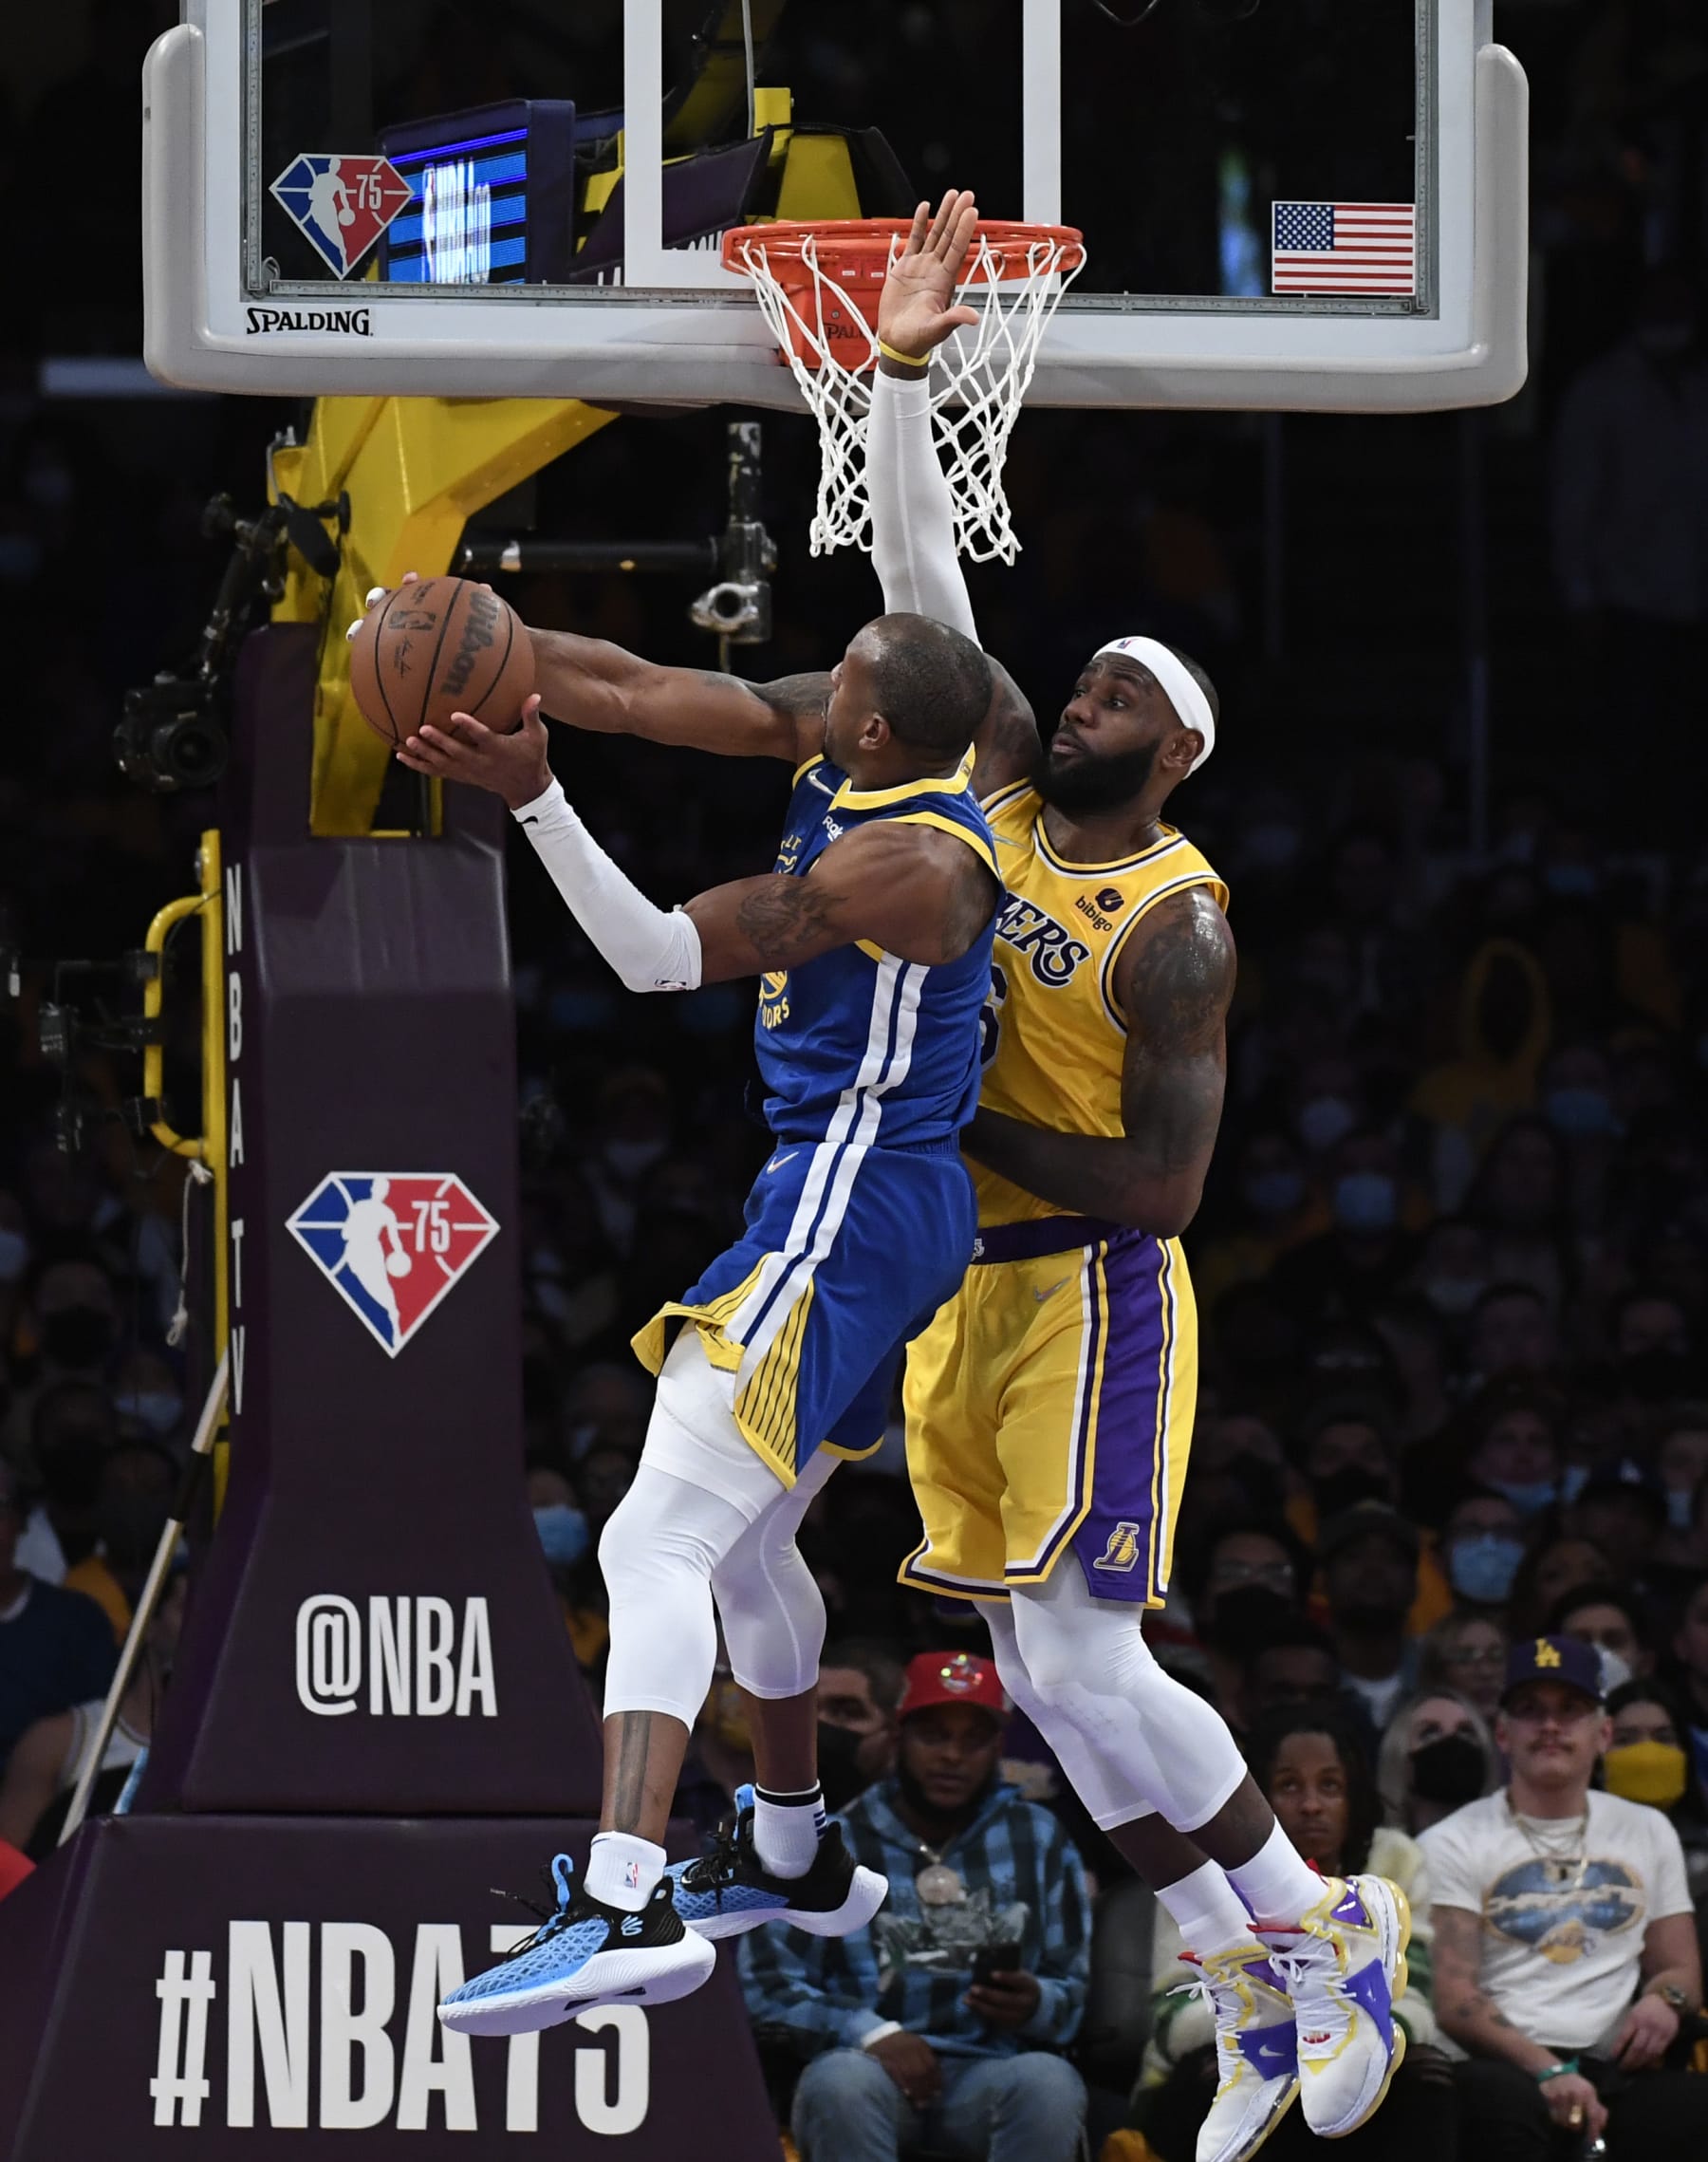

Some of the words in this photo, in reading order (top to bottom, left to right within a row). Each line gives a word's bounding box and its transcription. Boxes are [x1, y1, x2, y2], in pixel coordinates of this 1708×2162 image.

[356, 174, 382, 210] 75
[246, 307, 370, 337] SPALDING
[1074, 894, 1113, 933] bibigo
[410, 1200, 451, 1254] 75
[294, 1593, 498, 1717] @NBA
